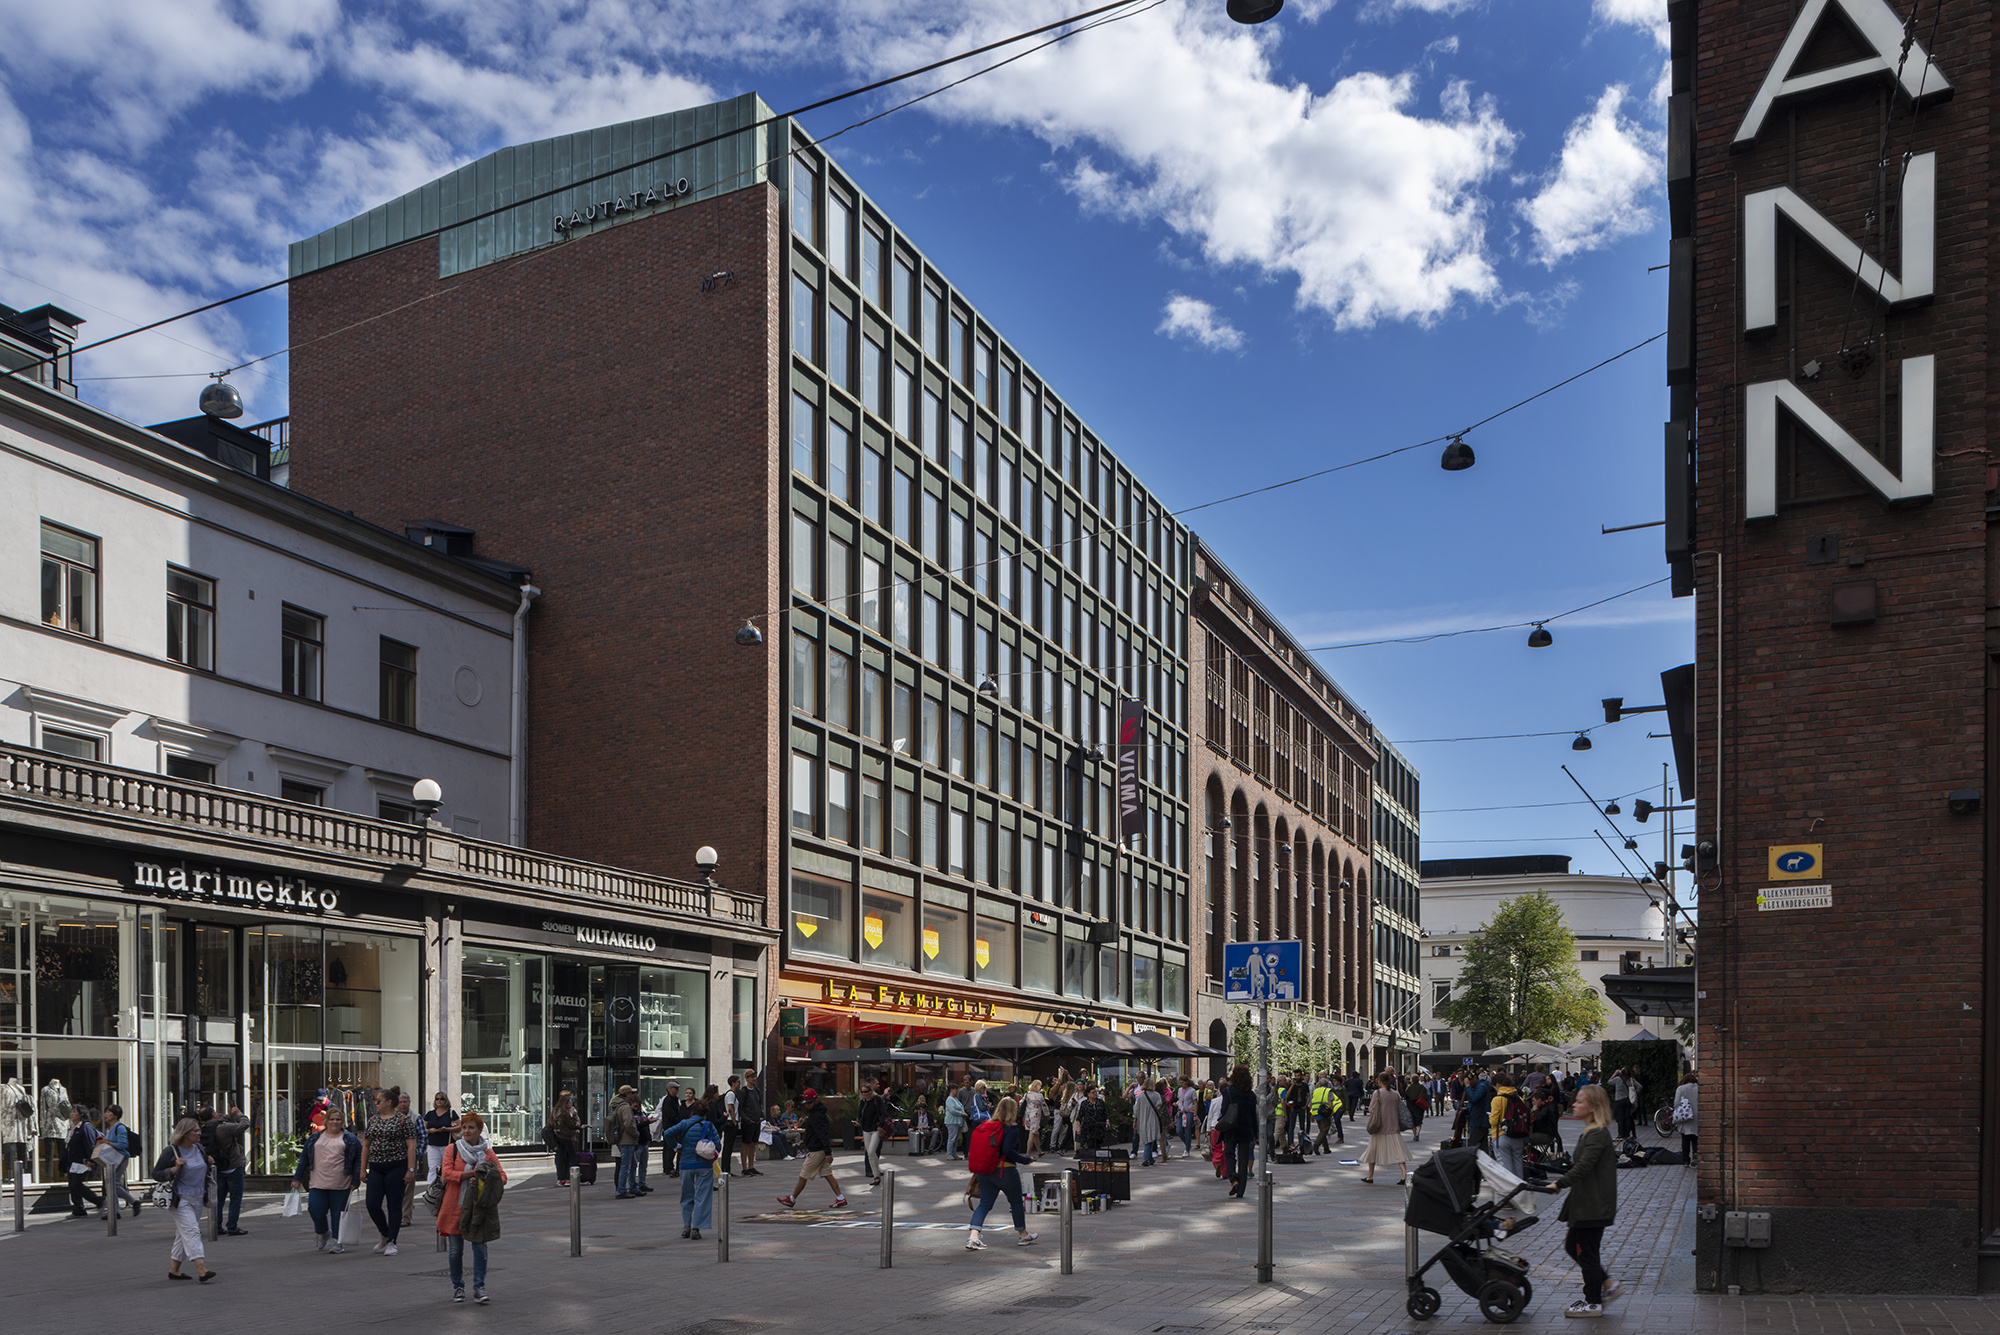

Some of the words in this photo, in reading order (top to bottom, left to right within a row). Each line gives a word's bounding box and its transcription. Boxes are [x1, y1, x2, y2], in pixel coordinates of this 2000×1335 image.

[554, 177, 689, 231] RAUTATALO
[1120, 750, 1137, 816] VISMA
[134, 861, 338, 910] marimekko
[1763, 887, 1828, 898] ALEKSANTERINKATU
[1763, 898, 1829, 909] ALEXANDERSGATAN
[542, 921, 575, 934] SUOMEN
[576, 926, 656, 952] KULTAKELLO
[532, 990, 587, 1008] KAKELLO
[829, 979, 859, 1000] LA
[879, 986, 998, 1017] FAMIGLIA
